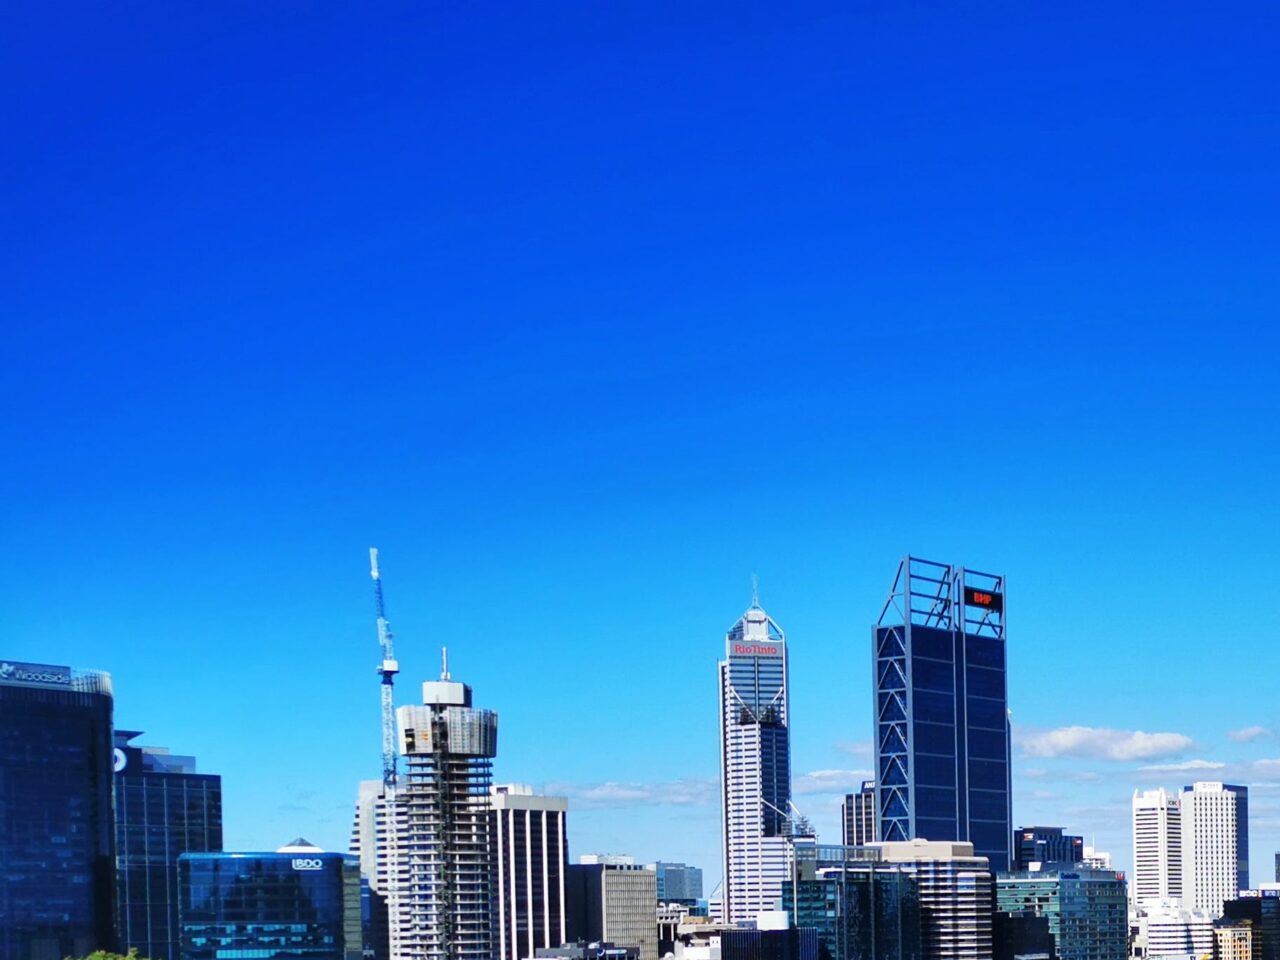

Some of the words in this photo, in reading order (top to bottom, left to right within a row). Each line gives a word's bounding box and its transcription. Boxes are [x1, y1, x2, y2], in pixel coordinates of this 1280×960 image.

[973, 591, 992, 605] BHP
[16, 669, 71, 684] Woodside
[295, 858, 323, 869] BDO
